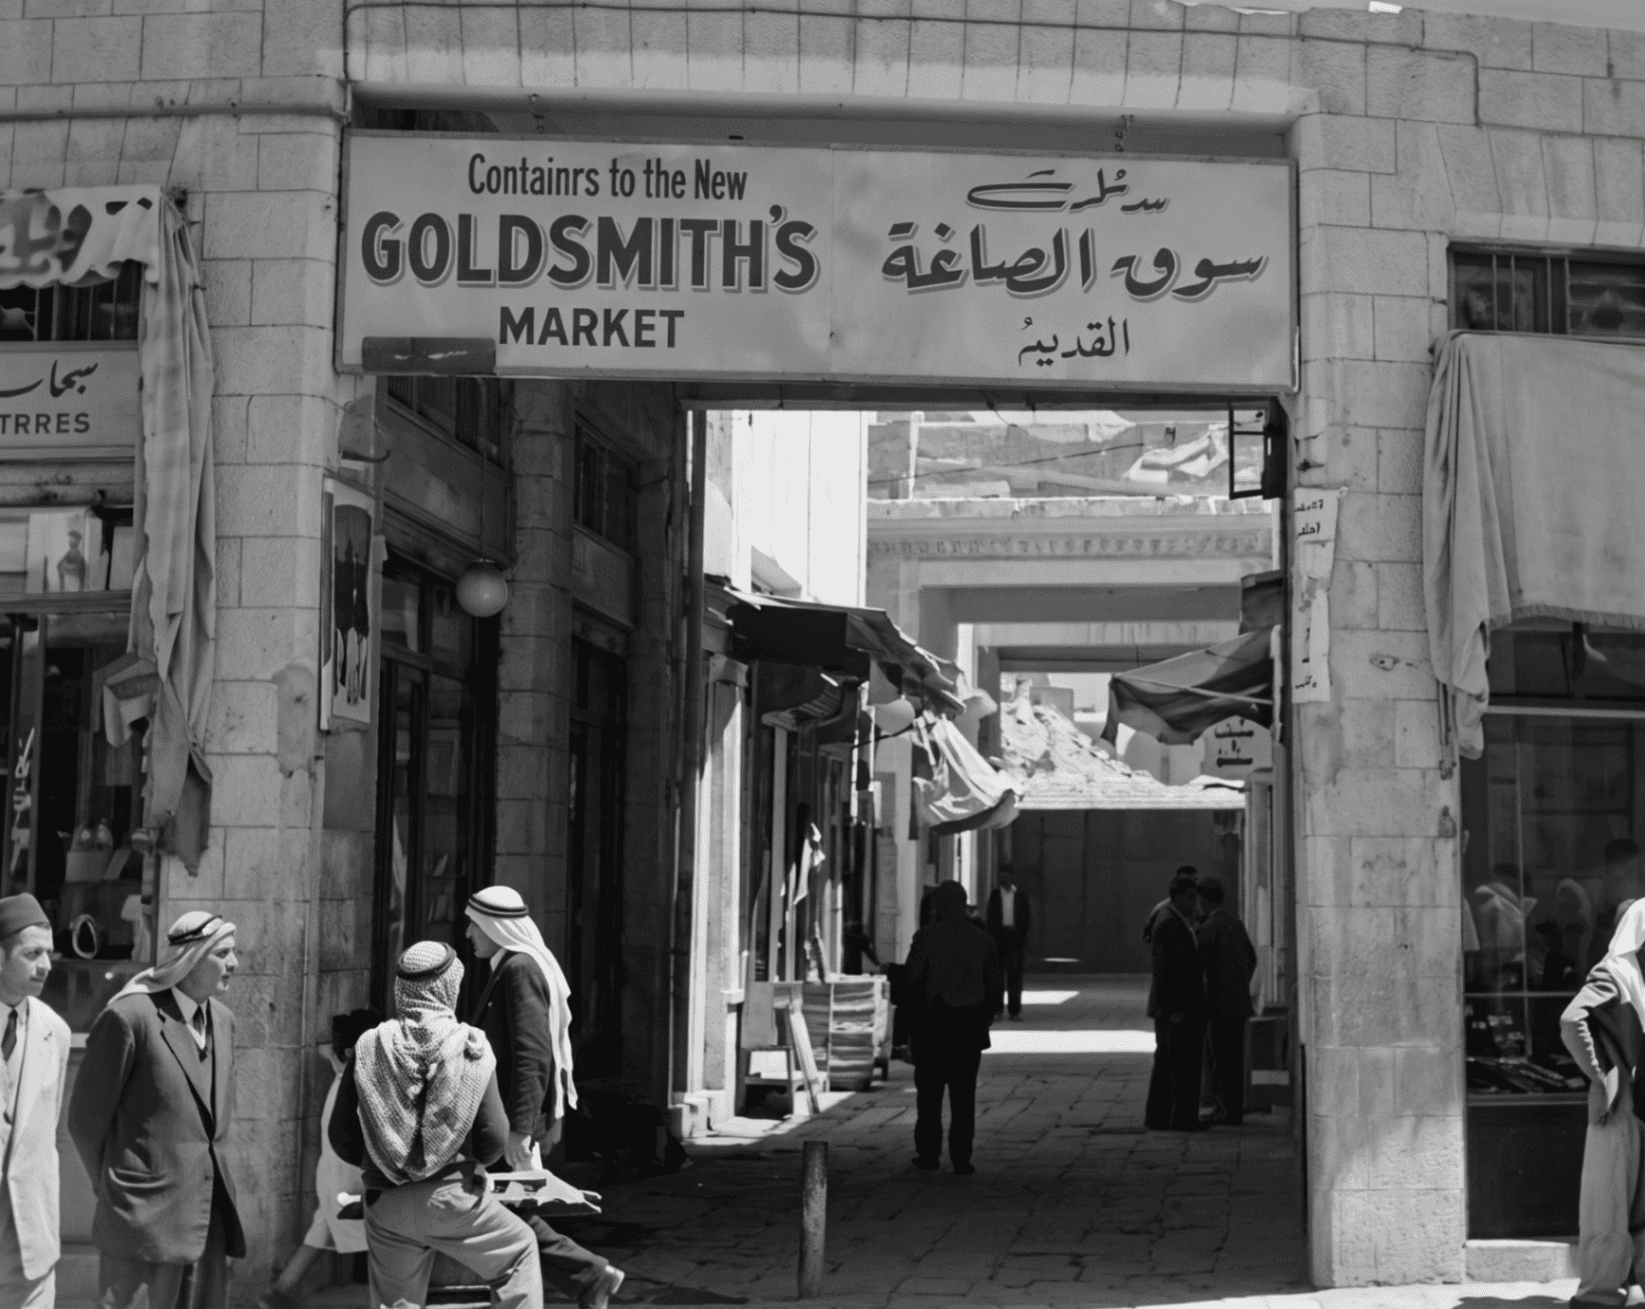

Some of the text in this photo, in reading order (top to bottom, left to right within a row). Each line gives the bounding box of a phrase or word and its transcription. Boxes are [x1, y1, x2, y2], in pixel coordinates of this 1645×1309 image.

[468, 153, 748, 201] Containrs to the New
[361, 204, 816, 291] GOLDSMITH'S
[498, 306, 685, 349] MARKET
